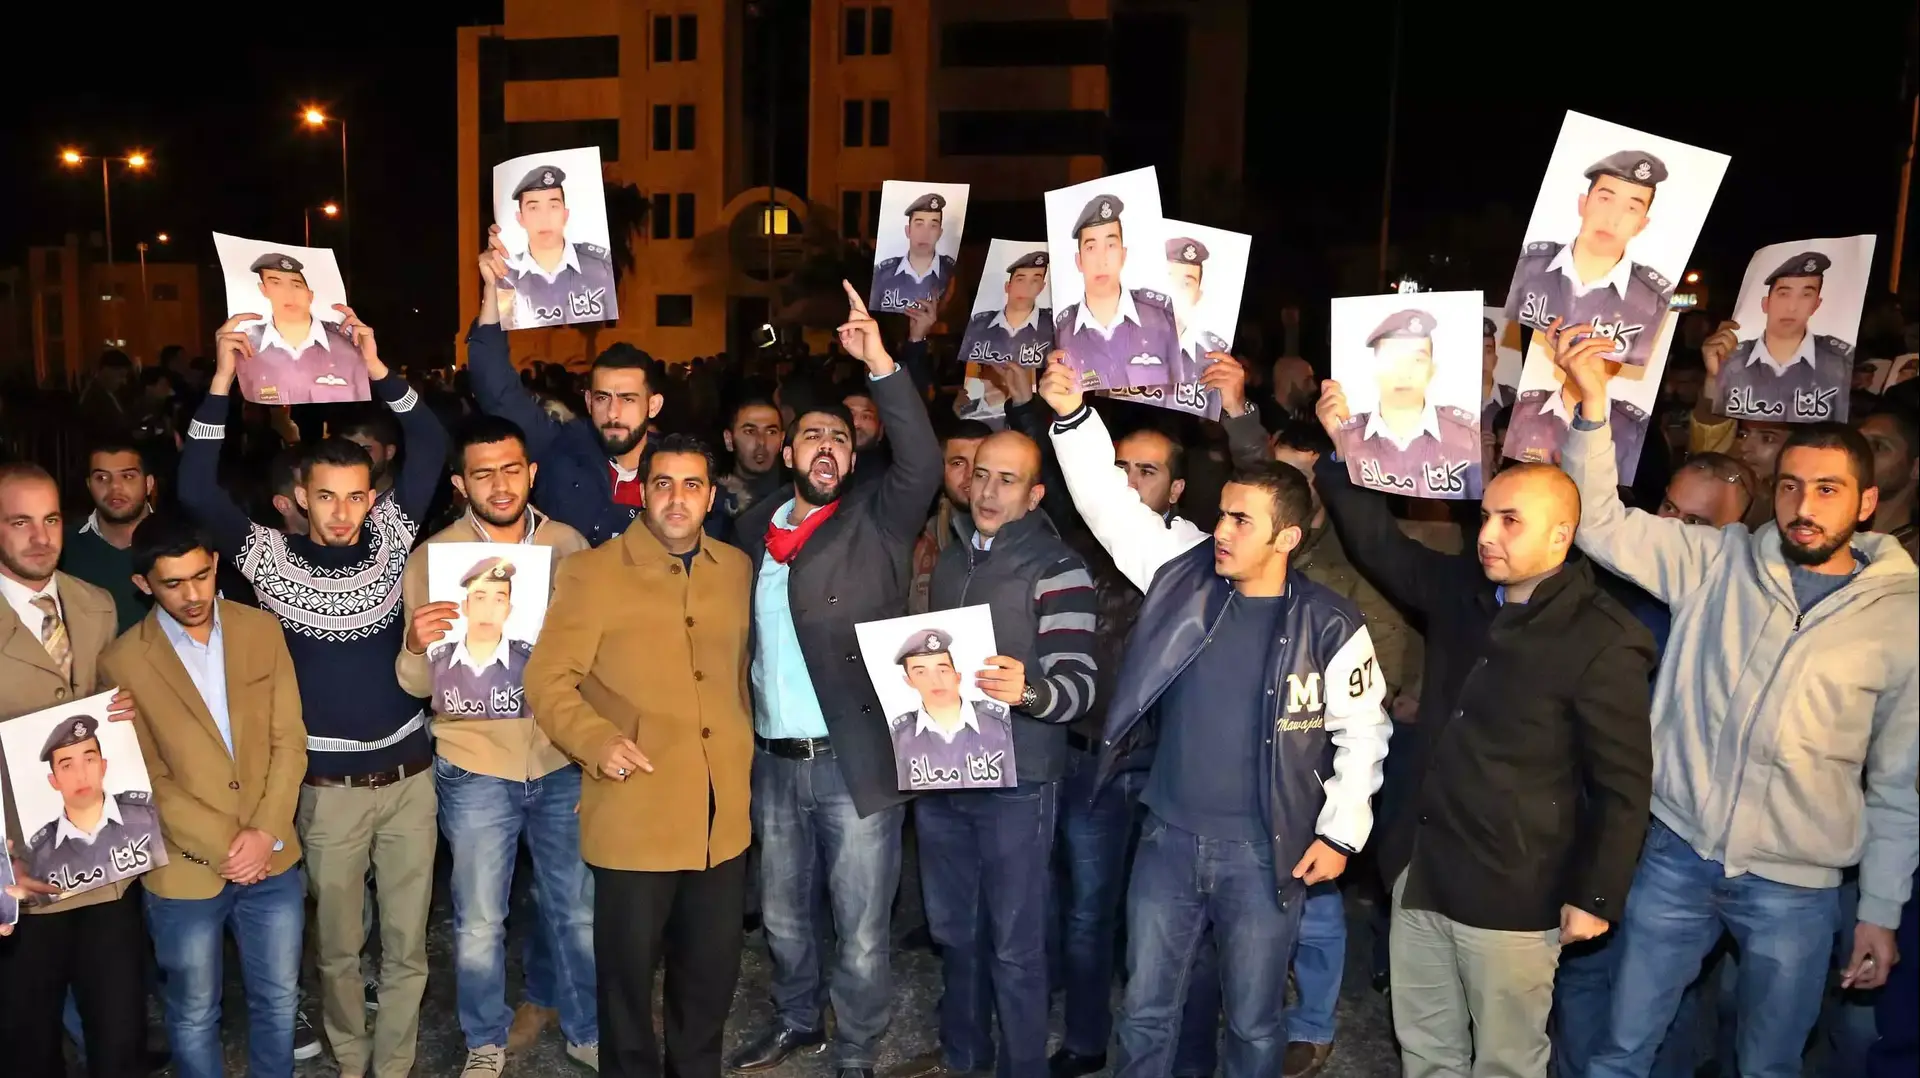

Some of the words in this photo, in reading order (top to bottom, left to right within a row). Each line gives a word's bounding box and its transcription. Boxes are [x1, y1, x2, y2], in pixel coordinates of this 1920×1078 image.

[569, 286, 605, 317] كلنا
[970, 341, 1012, 362] معاذ
[1020, 341, 1050, 364] كلنا
[1727, 387, 1784, 416] معاذ
[1794, 387, 1838, 417] كلنا
[1361, 460, 1414, 490] معاذ
[1423, 461, 1468, 492] كلنا
[1349, 656, 1373, 698] 97
[445, 687, 484, 714] معاذ
[492, 685, 525, 713] كلنا
[1286, 672, 1323, 713] M
[911, 756, 960, 784] معاذ
[968, 750, 1004, 781] كلنا
[111, 833, 150, 872] كلنا
